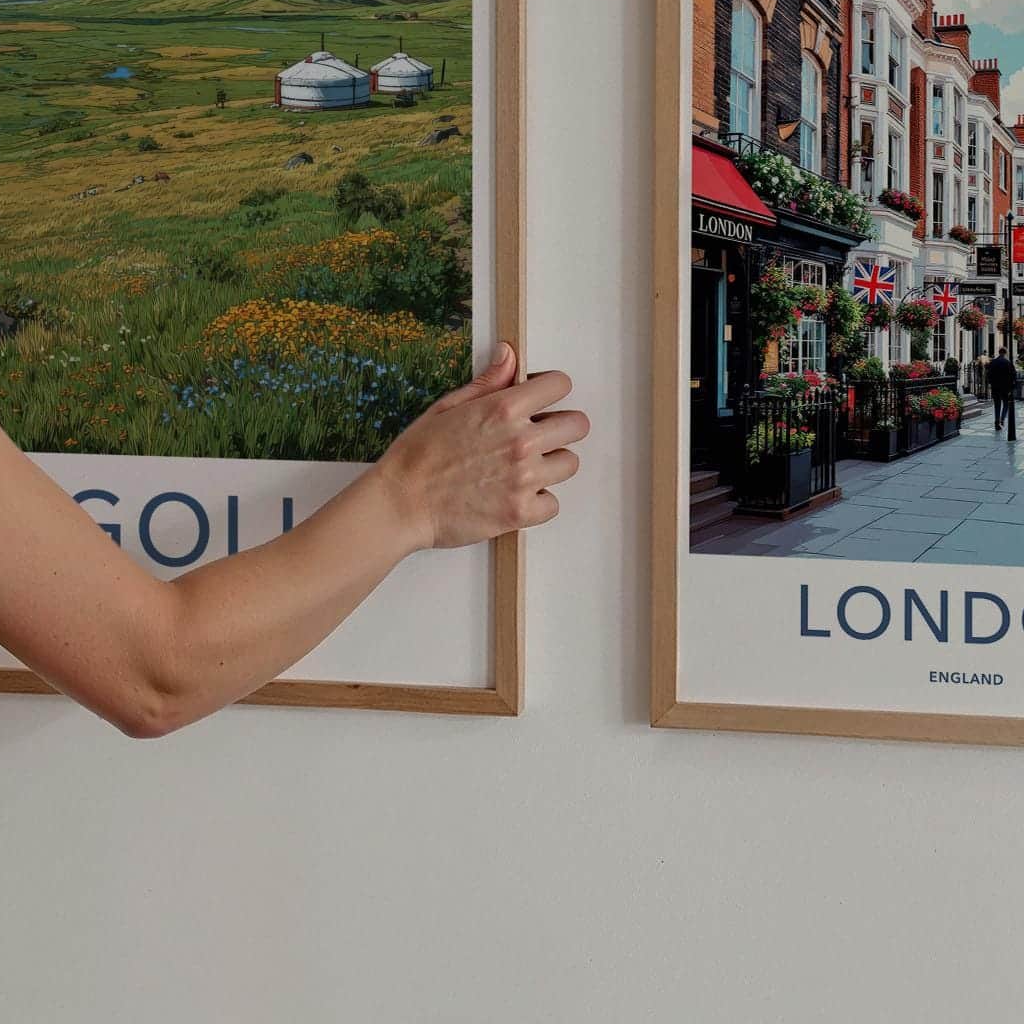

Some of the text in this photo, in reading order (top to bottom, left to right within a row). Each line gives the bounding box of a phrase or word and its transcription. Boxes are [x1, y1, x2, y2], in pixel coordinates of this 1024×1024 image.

[698, 213, 753, 242] LONDON
[800, 584, 1024, 644] LOND
[929, 671, 1004, 686] ENGLAND
